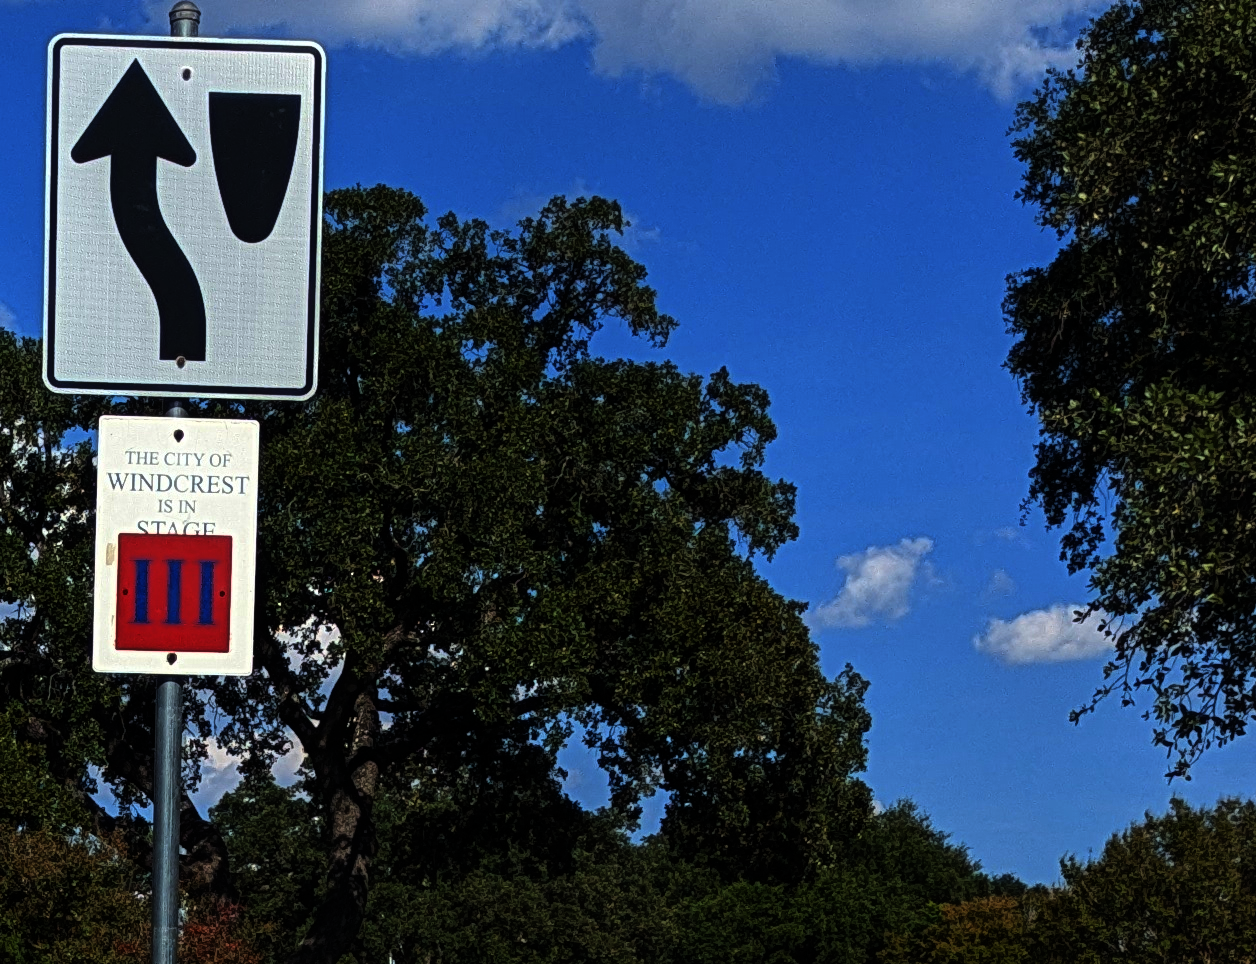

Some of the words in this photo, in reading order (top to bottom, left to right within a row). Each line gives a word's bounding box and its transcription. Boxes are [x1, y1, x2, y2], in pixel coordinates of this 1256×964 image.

[125, 451, 159, 465] THE
[164, 452, 204, 467] CITY
[210, 453, 232, 467] OF
[107, 473, 249, 495] WINDCREST
[158, 499, 173, 513] IS
[178, 500, 196, 514] IN
[129, 559, 219, 626] III
